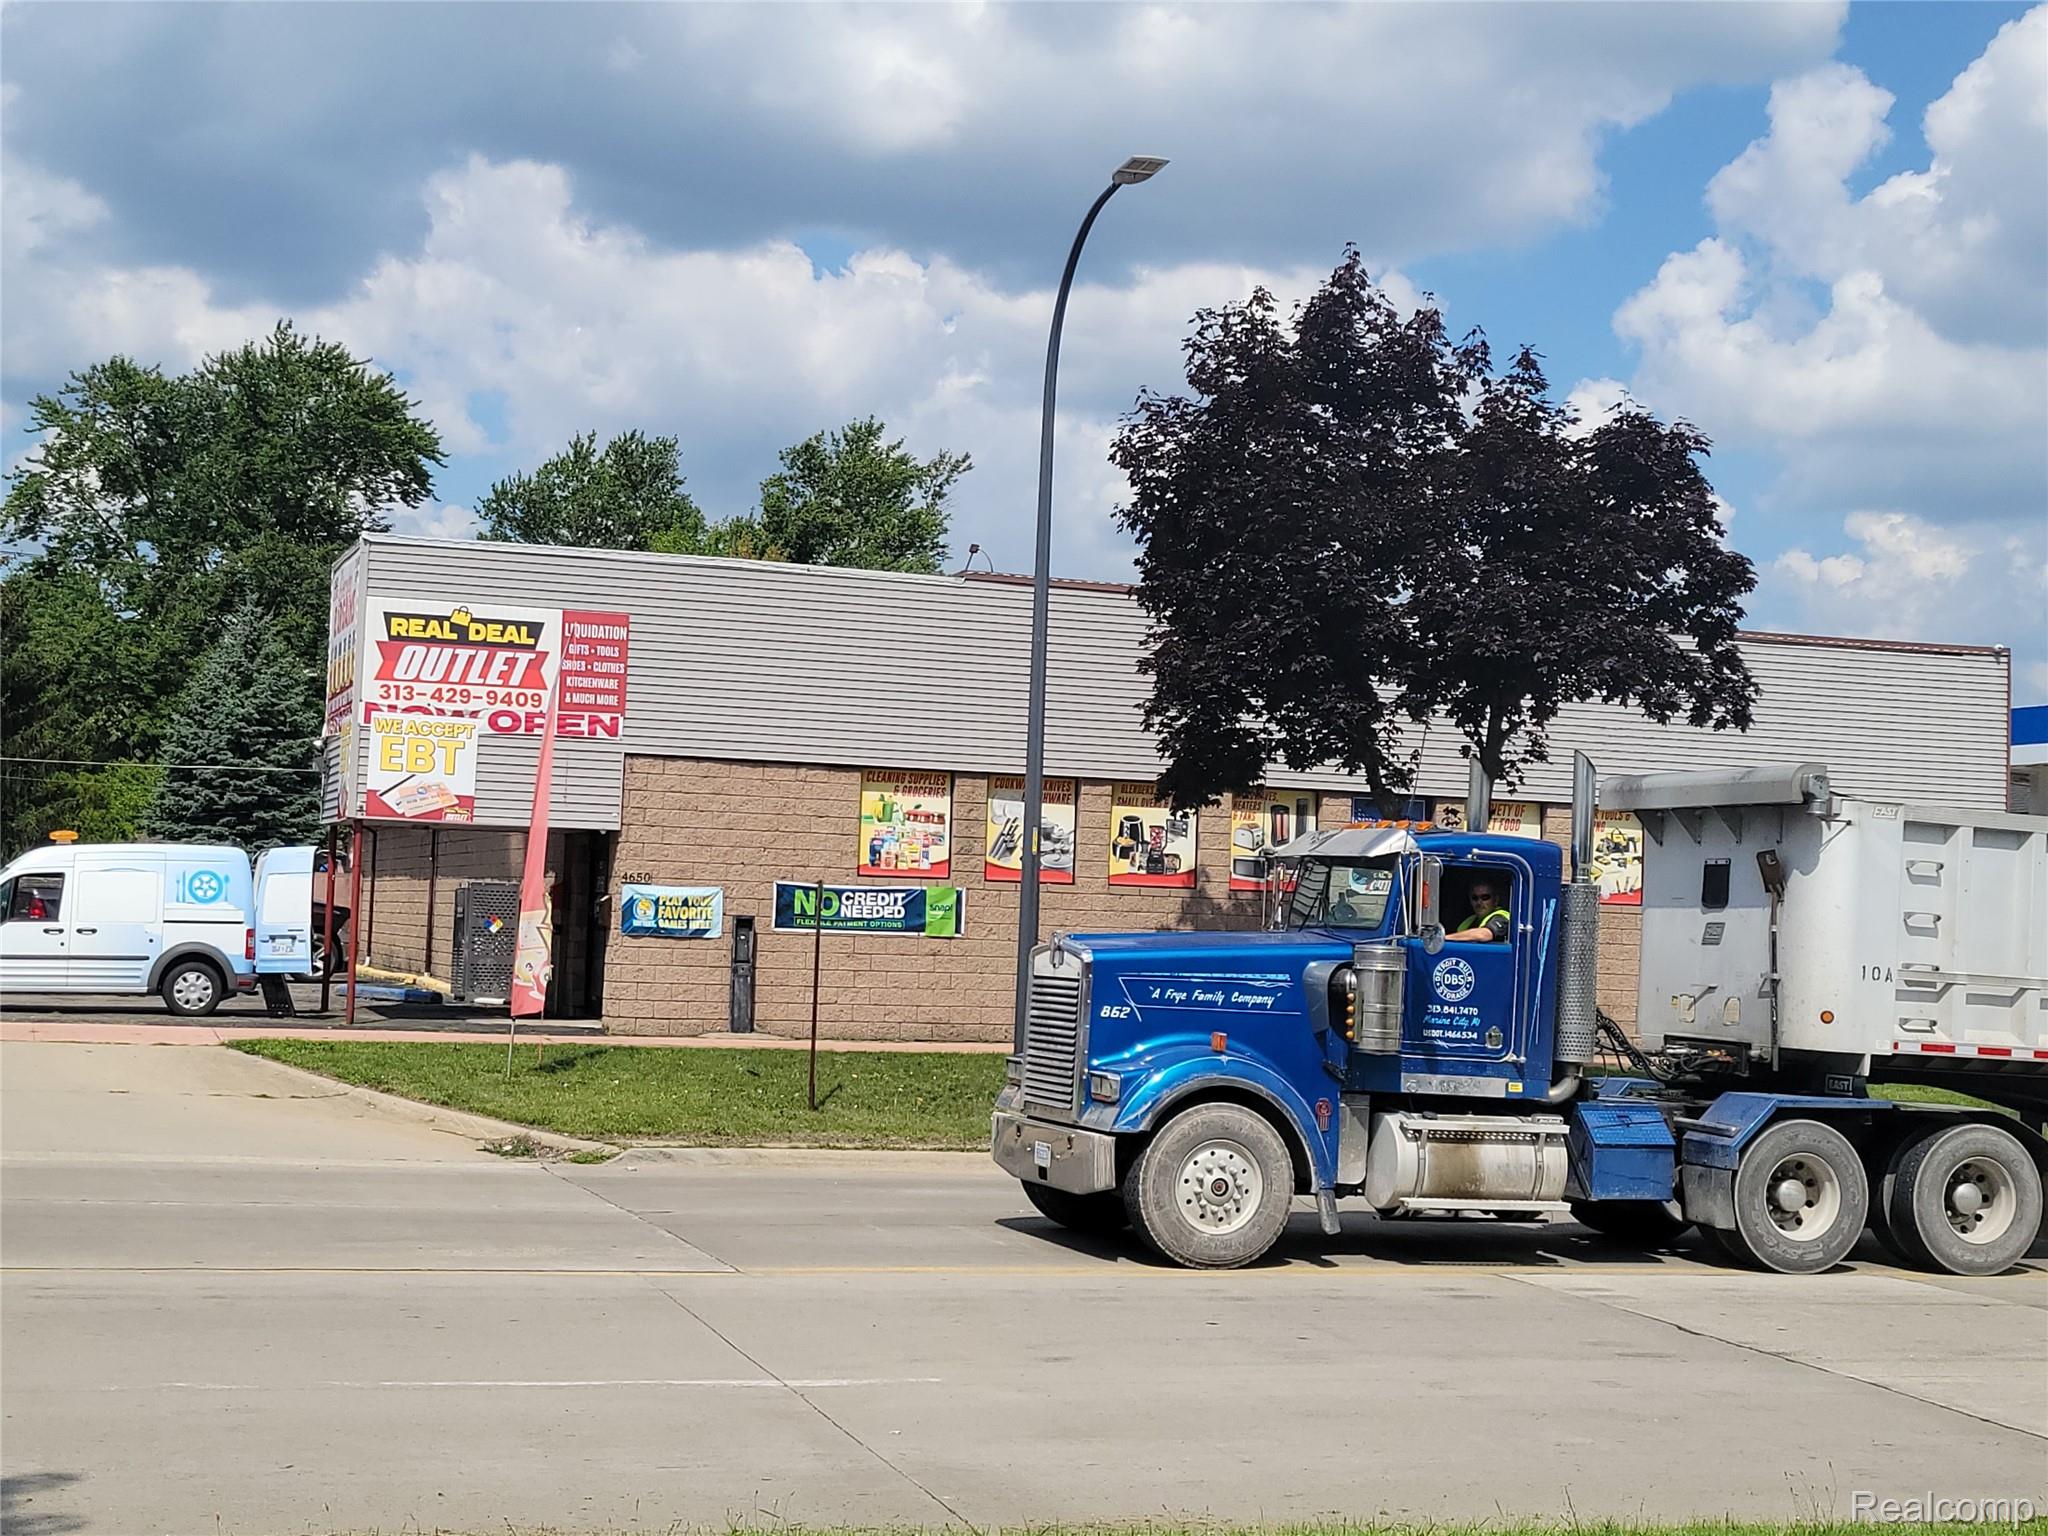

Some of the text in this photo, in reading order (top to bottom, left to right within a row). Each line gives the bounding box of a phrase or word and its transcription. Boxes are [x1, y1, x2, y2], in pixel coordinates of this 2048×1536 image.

[390, 617, 535, 645] REAL DEAL
[564, 623, 627, 640] LIQUIDATION
[568, 643, 619, 657] GIFTS TOOLS
[393, 645, 536, 687] OUTLET
[561, 660, 625, 674] SHOES CLOTHES
[566, 676, 619, 689] KITCHENWARE
[379, 684, 543, 708] 313-429-9409
[565, 692, 619, 706] & MUCH MORE
[373, 717, 476, 739] WE ACCEPT
[488, 709, 619, 737] OPEN
[380, 735, 465, 776] EBT
[866, 770, 947, 786] CLEANING SUPPLIES
[902, 785, 947, 799] GROCERIES
[1043, 780, 1072, 792] KNIVES
[1514, 804, 1527, 817] OF
[1873, 806, 1898, 817] EAST
[1499, 818, 1521, 831] FOOD
[621, 872, 651, 883] 4650
[659, 895, 682, 906] PLAY
[793, 889, 906, 916] NO CREDIT
[658, 906, 714, 919] FAVORITE
[840, 905, 905, 918] NEEDED
[658, 919, 687, 929] GAMES
[796, 918, 832, 927] FLEXLE
[833, 920, 868, 928] PAYMENT
[1435, 960, 1473, 982] DETROIT BULK
[1443, 973, 1465, 985] DBS
[1192, 989, 1225, 1006] Family
[1437, 986, 1469, 999] STORAGE
[1100, 1005, 1131, 1019] 862
